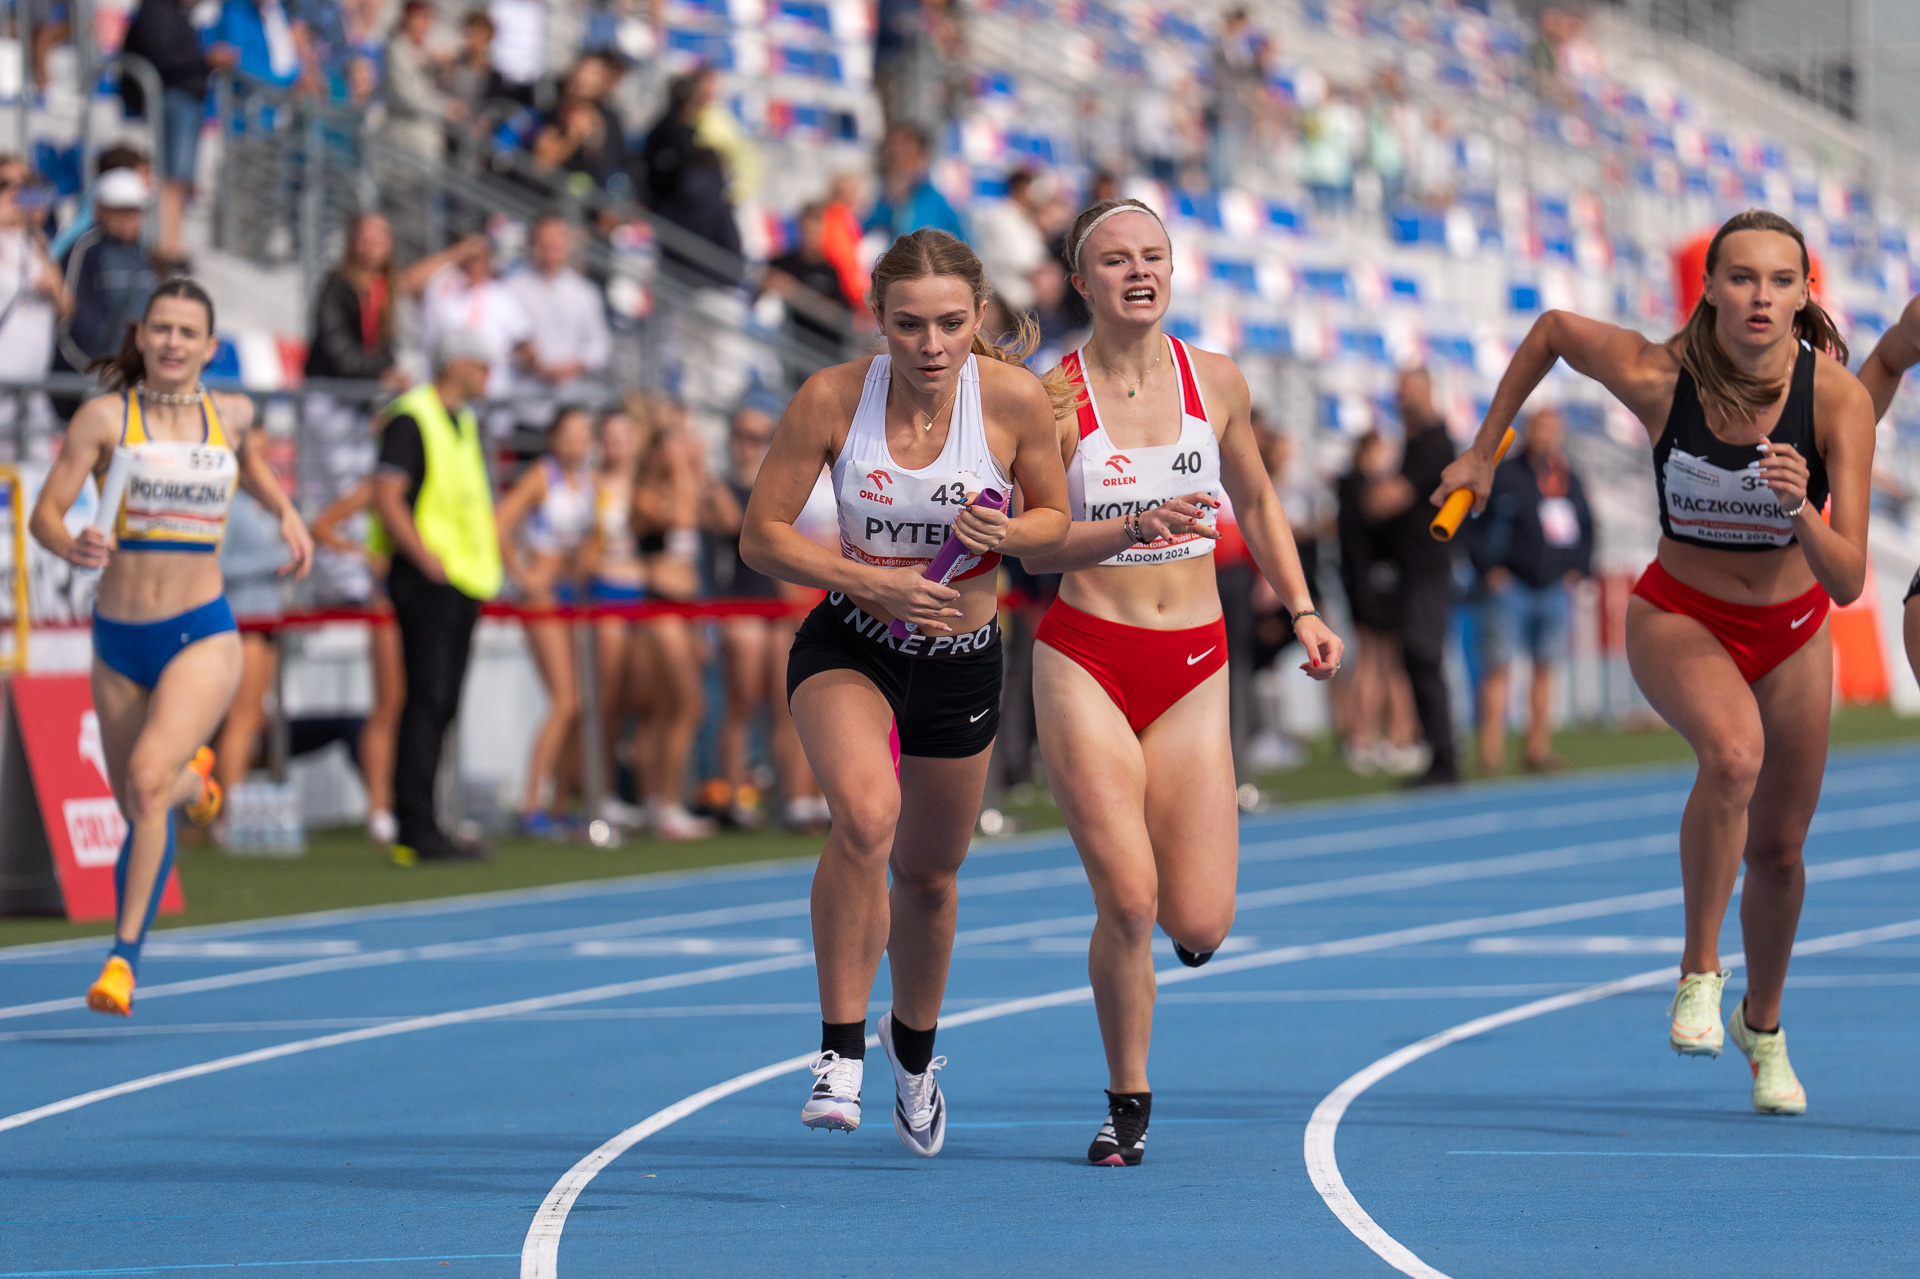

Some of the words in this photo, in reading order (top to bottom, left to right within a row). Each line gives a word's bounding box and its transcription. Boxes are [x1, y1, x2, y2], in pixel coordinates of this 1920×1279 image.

[1172, 451, 1202, 475] 40
[1103, 476, 1137, 487] ORLEN
[859, 489, 893, 506] ORLEN
[930, 482, 966, 506] 43
[1671, 493, 1787, 519] RACZKOWSK
[1697, 528, 1743, 541] RADOM
[1116, 553, 1163, 562] RADOM
[1164, 546, 1190, 560] 2024
[844, 607, 926, 656] NIKE
[927, 624, 990, 657] PRO
